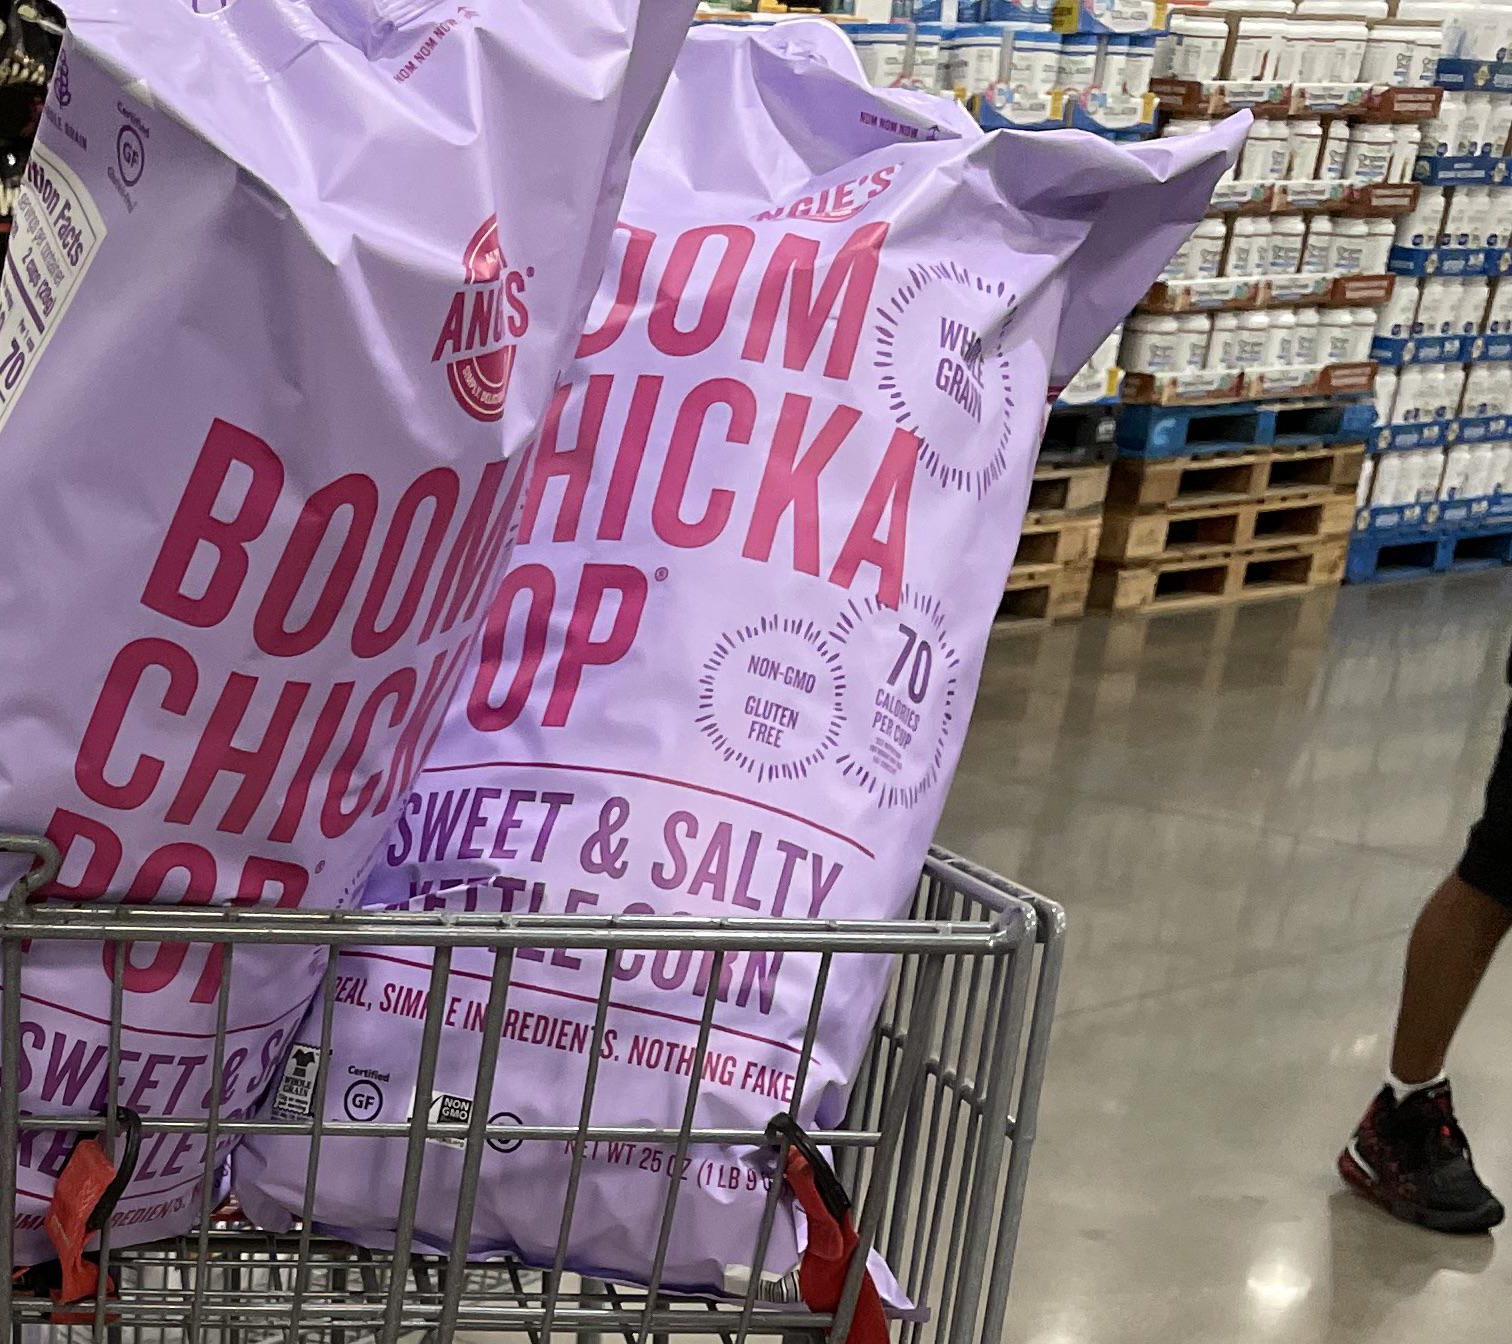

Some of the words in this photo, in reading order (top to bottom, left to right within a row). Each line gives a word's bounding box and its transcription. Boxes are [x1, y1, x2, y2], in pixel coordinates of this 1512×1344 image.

[516, 372, 925, 611] HICKA
[466, 562, 648, 732] OP
[886, 623, 932, 704] 70
[746, 654, 817, 695] NON-GMO
[743, 694, 799, 731] GLUTEN
[874, 688, 921, 732] CALORIES
[747, 717, 783, 749] FREE
[872, 711, 894, 737] PER
[893, 724, 912, 750] CUP
[387, 787, 576, 868] SWEET
[579, 796, 632, 880] &
[650, 809, 844, 920] SALTY
[347, 1064, 391, 1083] Certified
[351, 1092, 376, 1111] GF
[441, 1107, 468, 1121] GMO
[443, 1097, 470, 1111] NON
